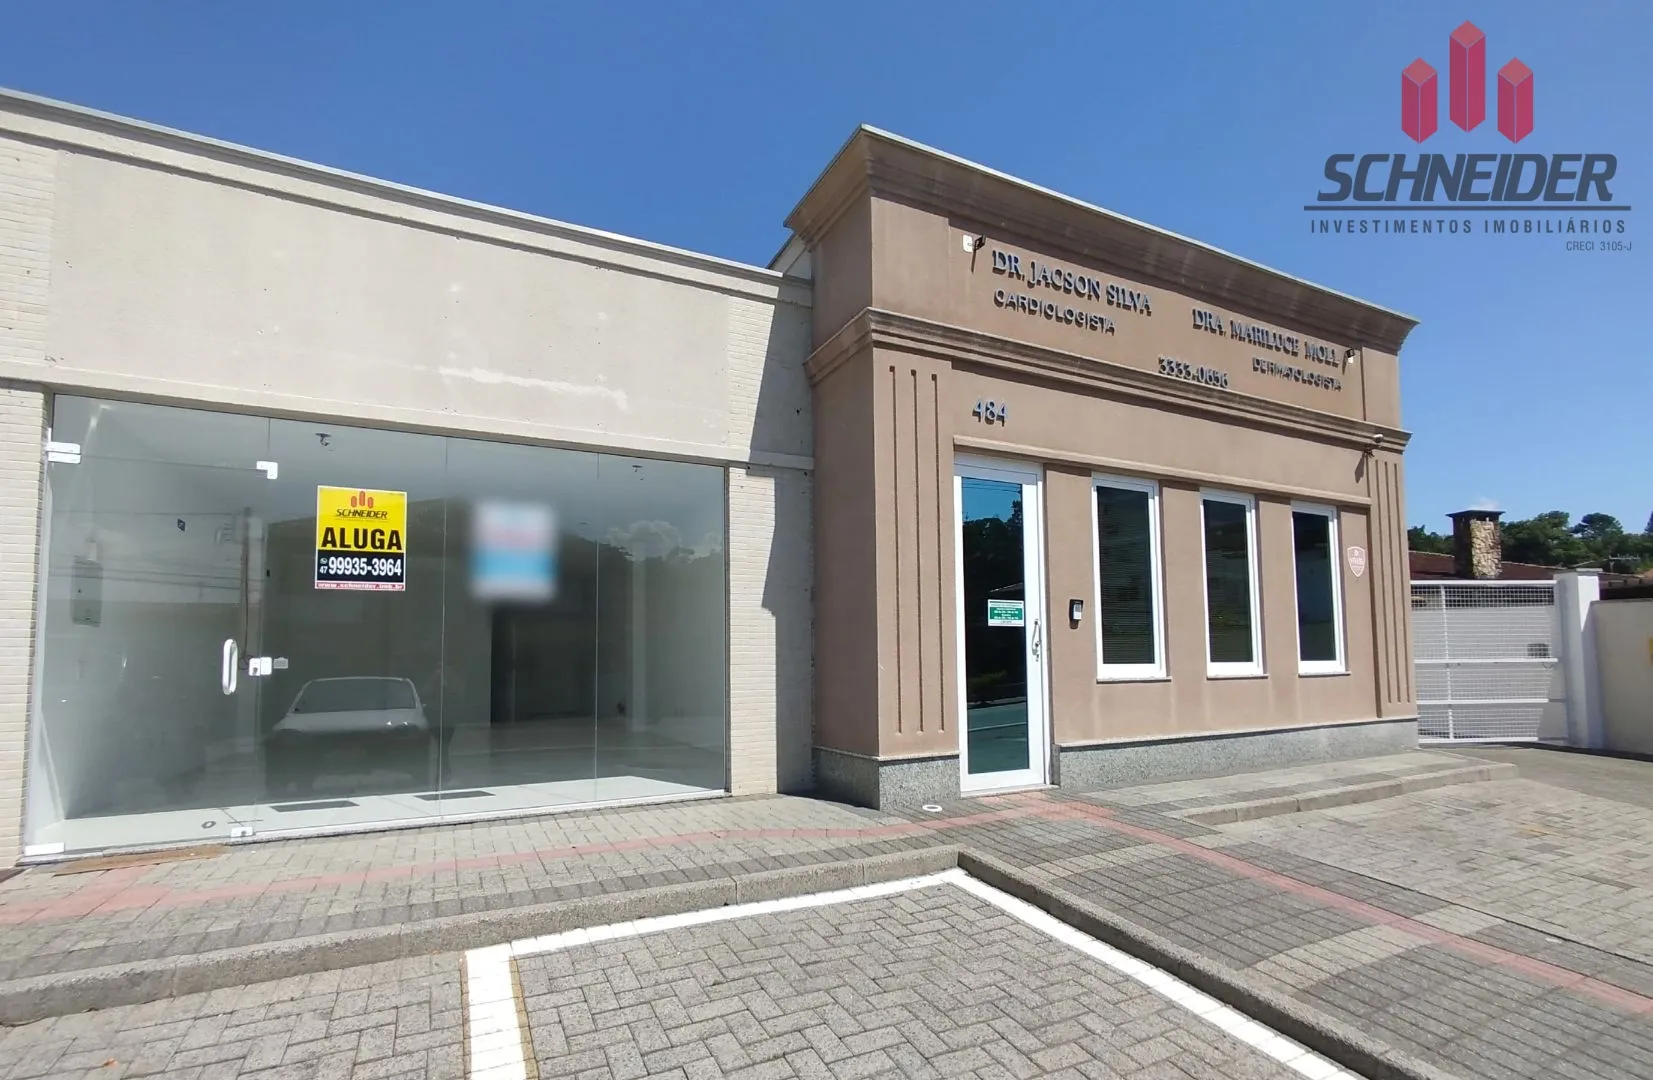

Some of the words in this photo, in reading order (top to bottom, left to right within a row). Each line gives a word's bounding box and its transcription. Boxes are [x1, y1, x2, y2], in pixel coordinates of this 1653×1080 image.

[992, 249, 1025, 281] DR.
[1027, 260, 1101, 302] JACSON
[1105, 283, 1152, 316] SILVA
[993, 289, 1116, 336] CARDIOLOGISTA
[1192, 308, 1226, 337] DRA.
[1230, 319, 1300, 357] MARILUCE
[1304, 341, 1341, 369] MOLL
[1252, 356, 1342, 392] DERMATOLOGISTA
[971, 399, 1007, 428] 484
[336, 509, 388, 519] SCHNEIDER
[321, 527, 402, 550] ALUGA
[320, 566, 328, 574] 47
[328, 556, 402, 576] 99935-3964
